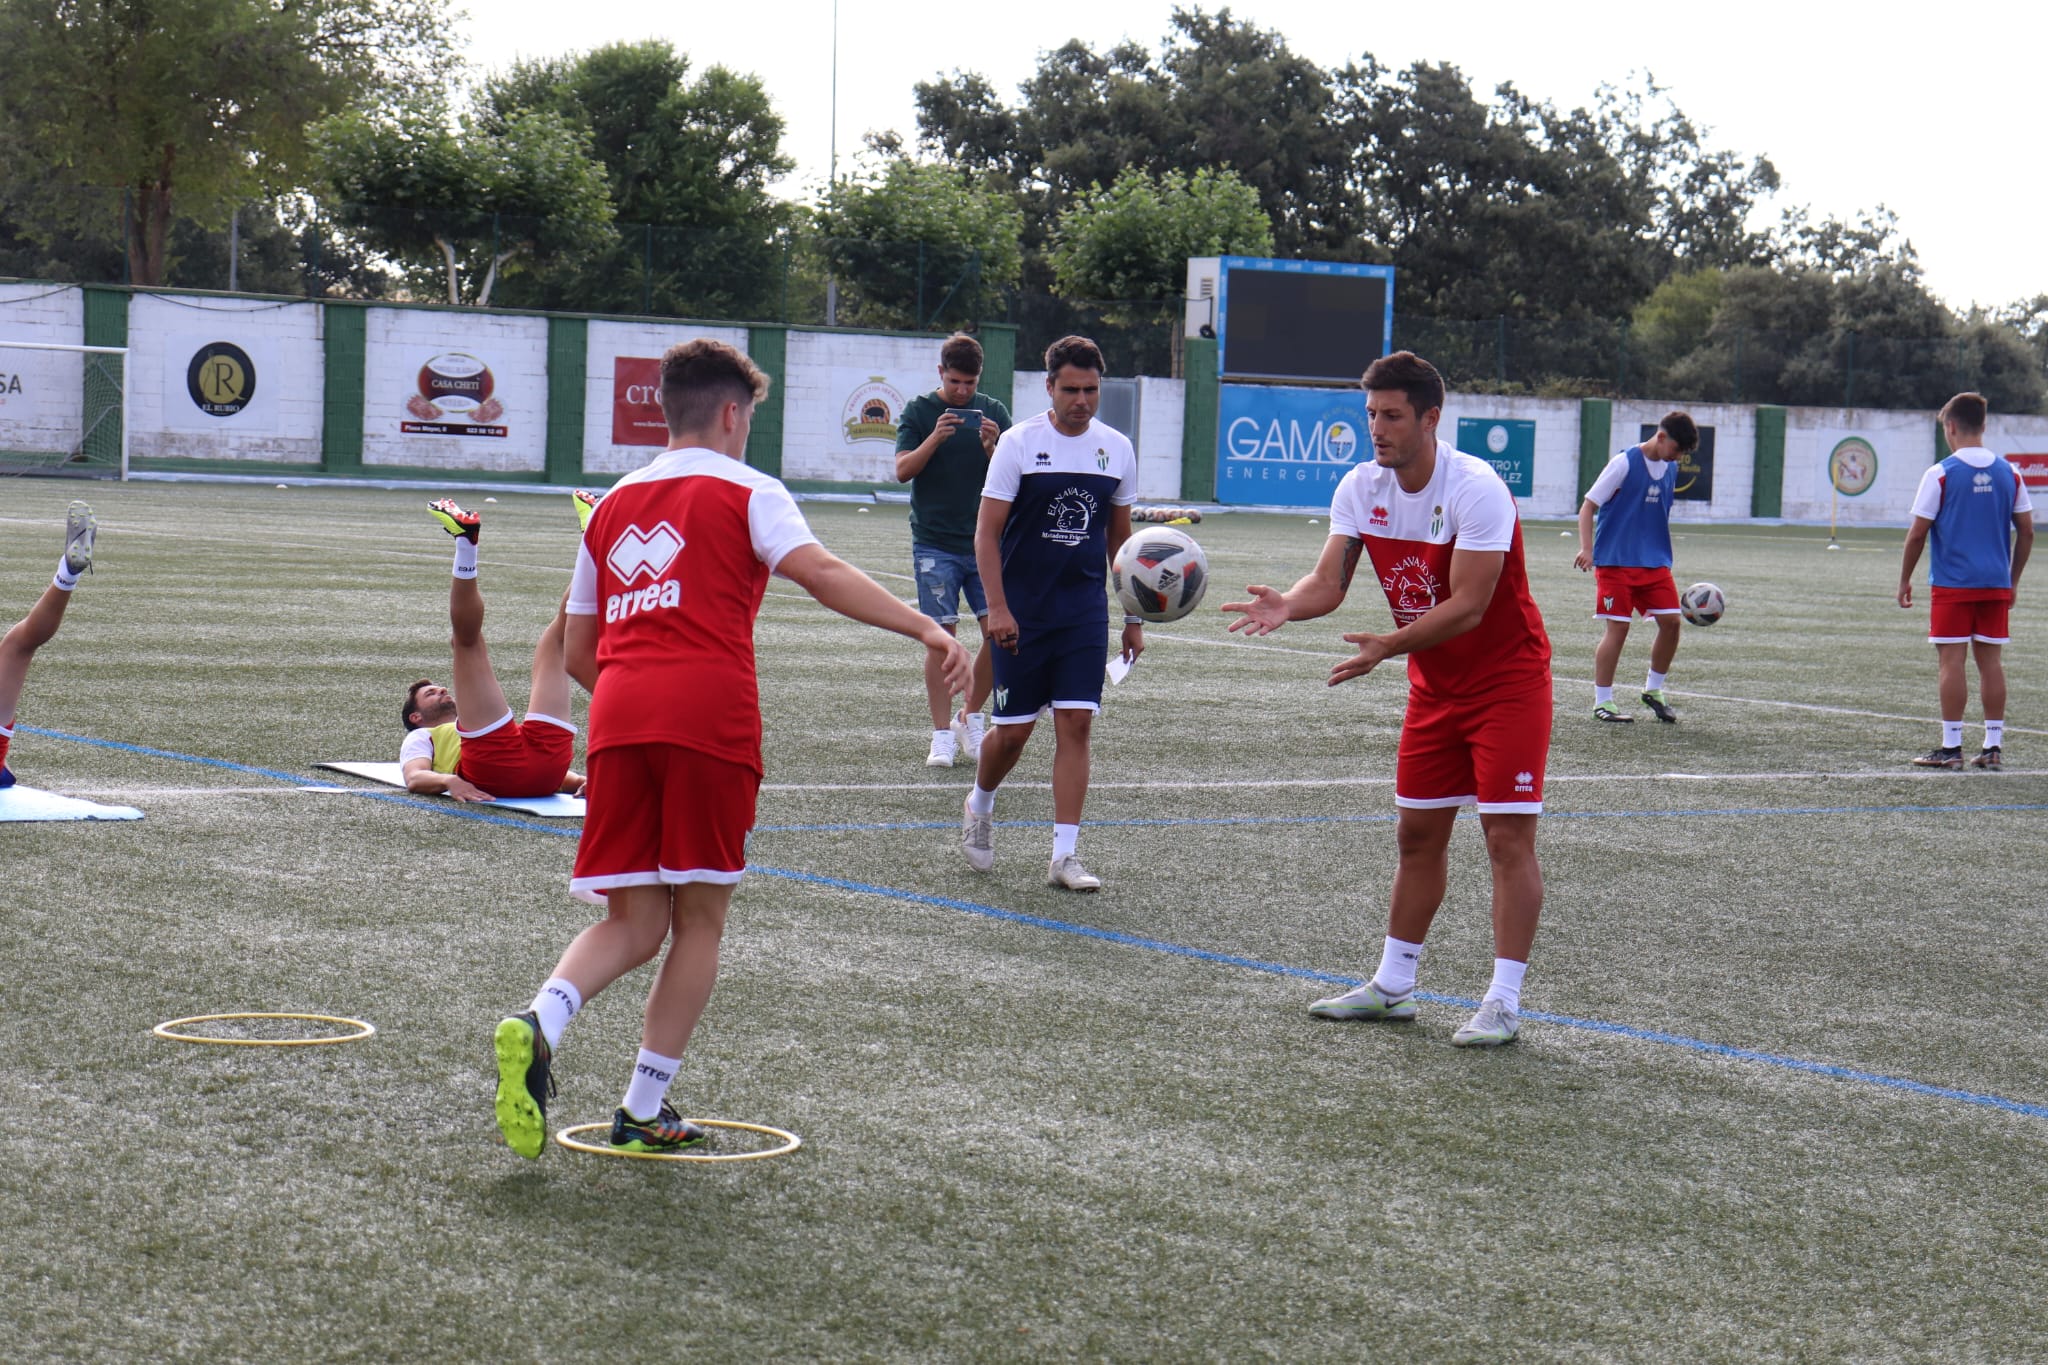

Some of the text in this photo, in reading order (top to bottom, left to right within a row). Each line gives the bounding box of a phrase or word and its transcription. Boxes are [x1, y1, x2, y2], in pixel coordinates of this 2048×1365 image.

[431, 379, 453, 389] CASA
[1227, 416, 1357, 463] GAMO
[1489, 459, 1511, 471] TRO
[1369, 518, 1388, 526] errea
[606, 579, 681, 624] errea
[548, 986, 574, 1016] errea
[637, 1061, 672, 1082] errea
